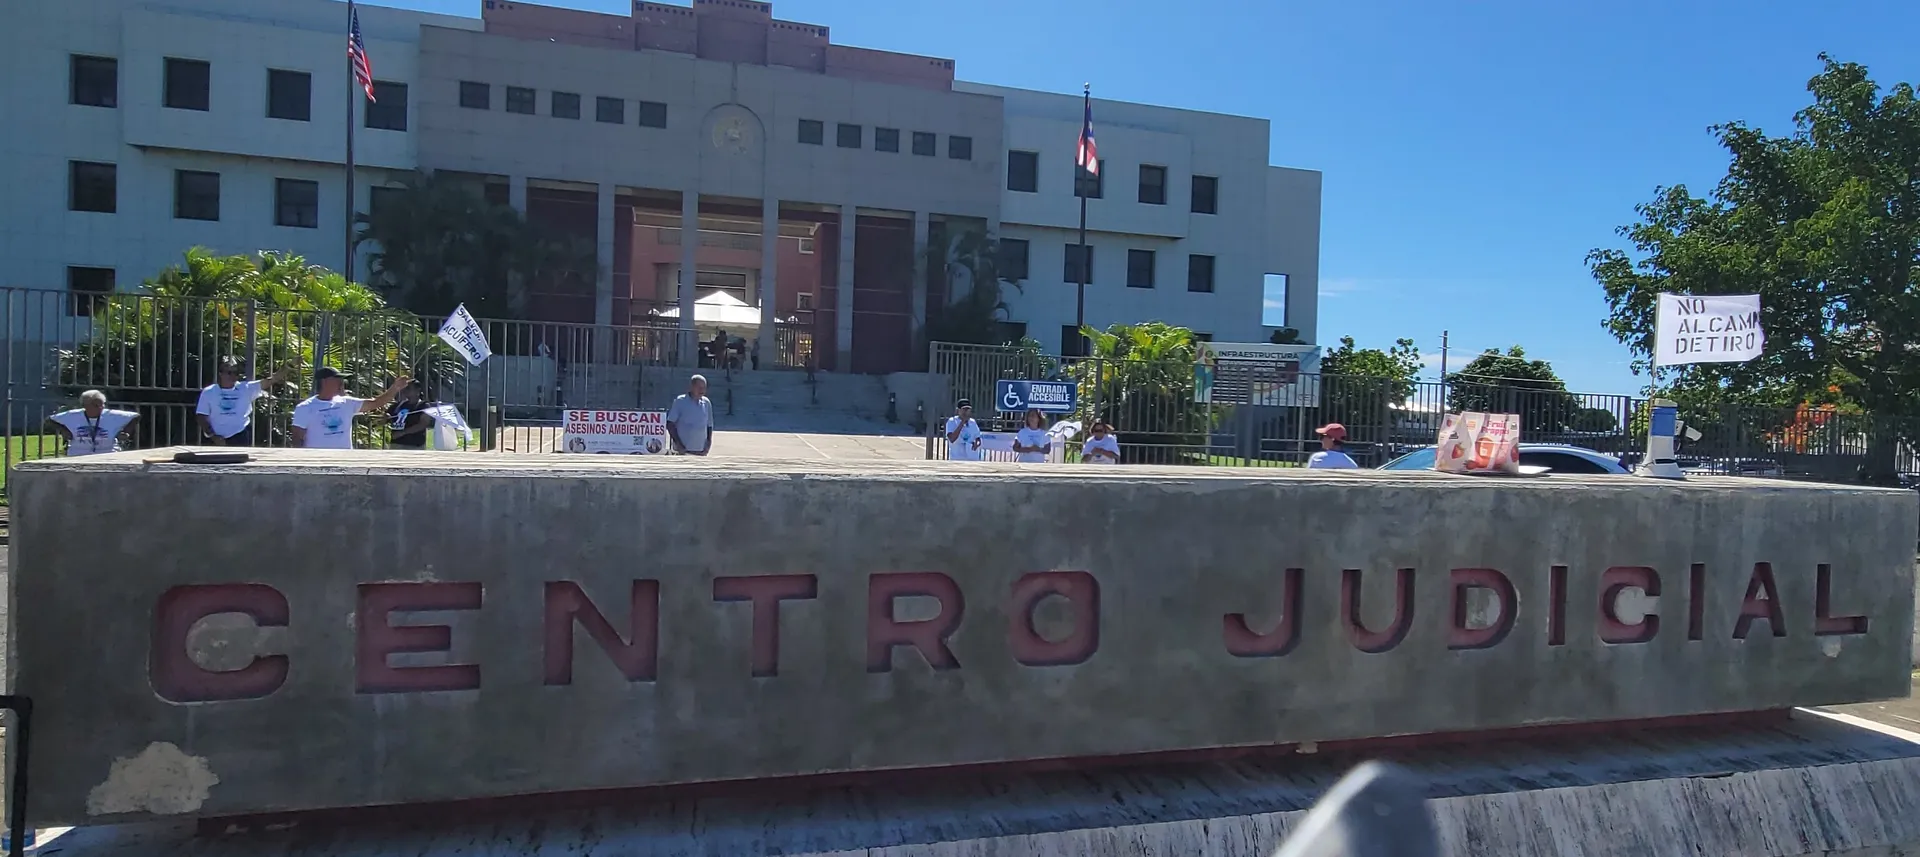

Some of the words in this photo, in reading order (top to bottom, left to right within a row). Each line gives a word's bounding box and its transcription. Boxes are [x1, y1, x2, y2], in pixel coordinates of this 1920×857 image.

[1677, 298, 1706, 316] NO
[462, 326, 473, 340] EL
[443, 324, 482, 360] ACUIFERO
[1218, 350, 1300, 360] INFRAESTRUCTURA
[1031, 384, 1068, 394] ENTRADA
[1028, 392, 1071, 403] ACCESIBLE
[568, 411, 590, 422] SE
[595, 411, 661, 424] BUSCAN
[565, 423, 607, 435] ASESINOS
[608, 424, 665, 436] AMBIENTALES
[149, 570, 1101, 705] CENTRO
[1222, 562, 1869, 658] JUDICIAL
